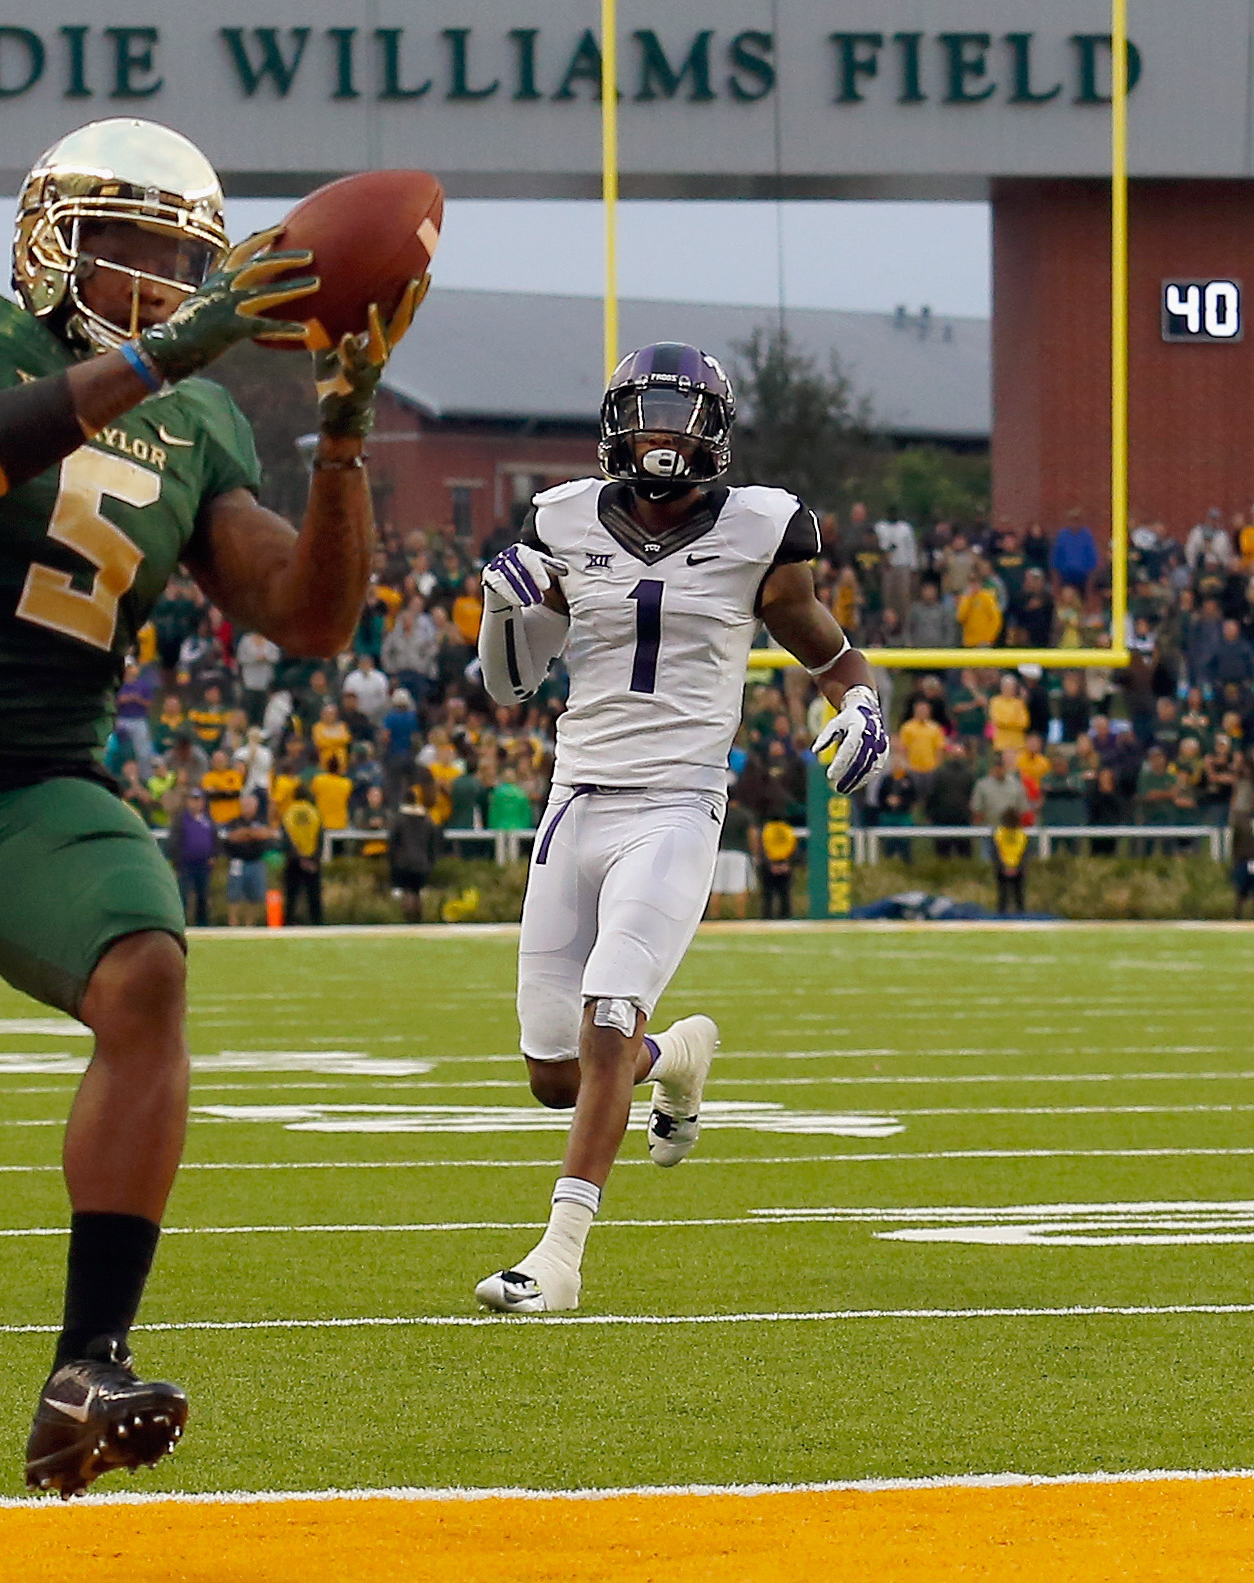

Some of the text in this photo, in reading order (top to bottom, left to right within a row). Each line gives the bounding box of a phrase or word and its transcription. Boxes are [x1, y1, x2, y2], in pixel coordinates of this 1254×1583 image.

[218, 25, 778, 105] WILLIAMS
[827, 29, 1144, 108] FIELD
[1166, 281, 1239, 337] 40
[96, 426, 167, 471] YLOR
[14, 443, 163, 653] 5
[626, 579, 666, 694] 1
